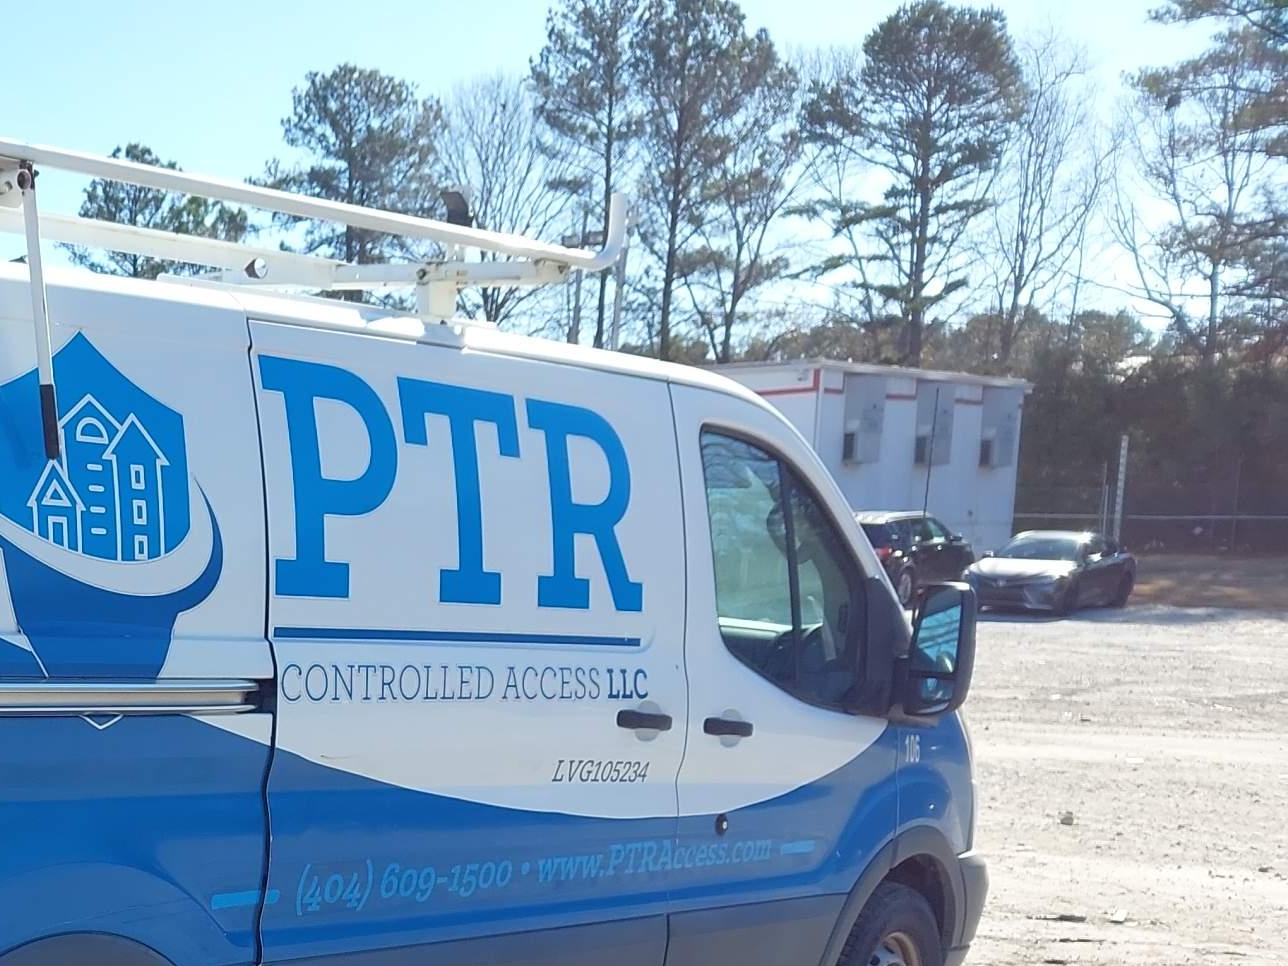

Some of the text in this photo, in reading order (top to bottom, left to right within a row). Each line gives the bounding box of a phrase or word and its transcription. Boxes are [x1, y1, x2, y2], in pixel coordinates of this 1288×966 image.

[259, 355, 643, 611] PTR
[281, 663, 648, 701] CONTROLLED ACCESS LLC
[552, 759, 650, 783] LVG105234
[296, 839, 772, 916] (404) 609-1500 www.PTRAccess.com
